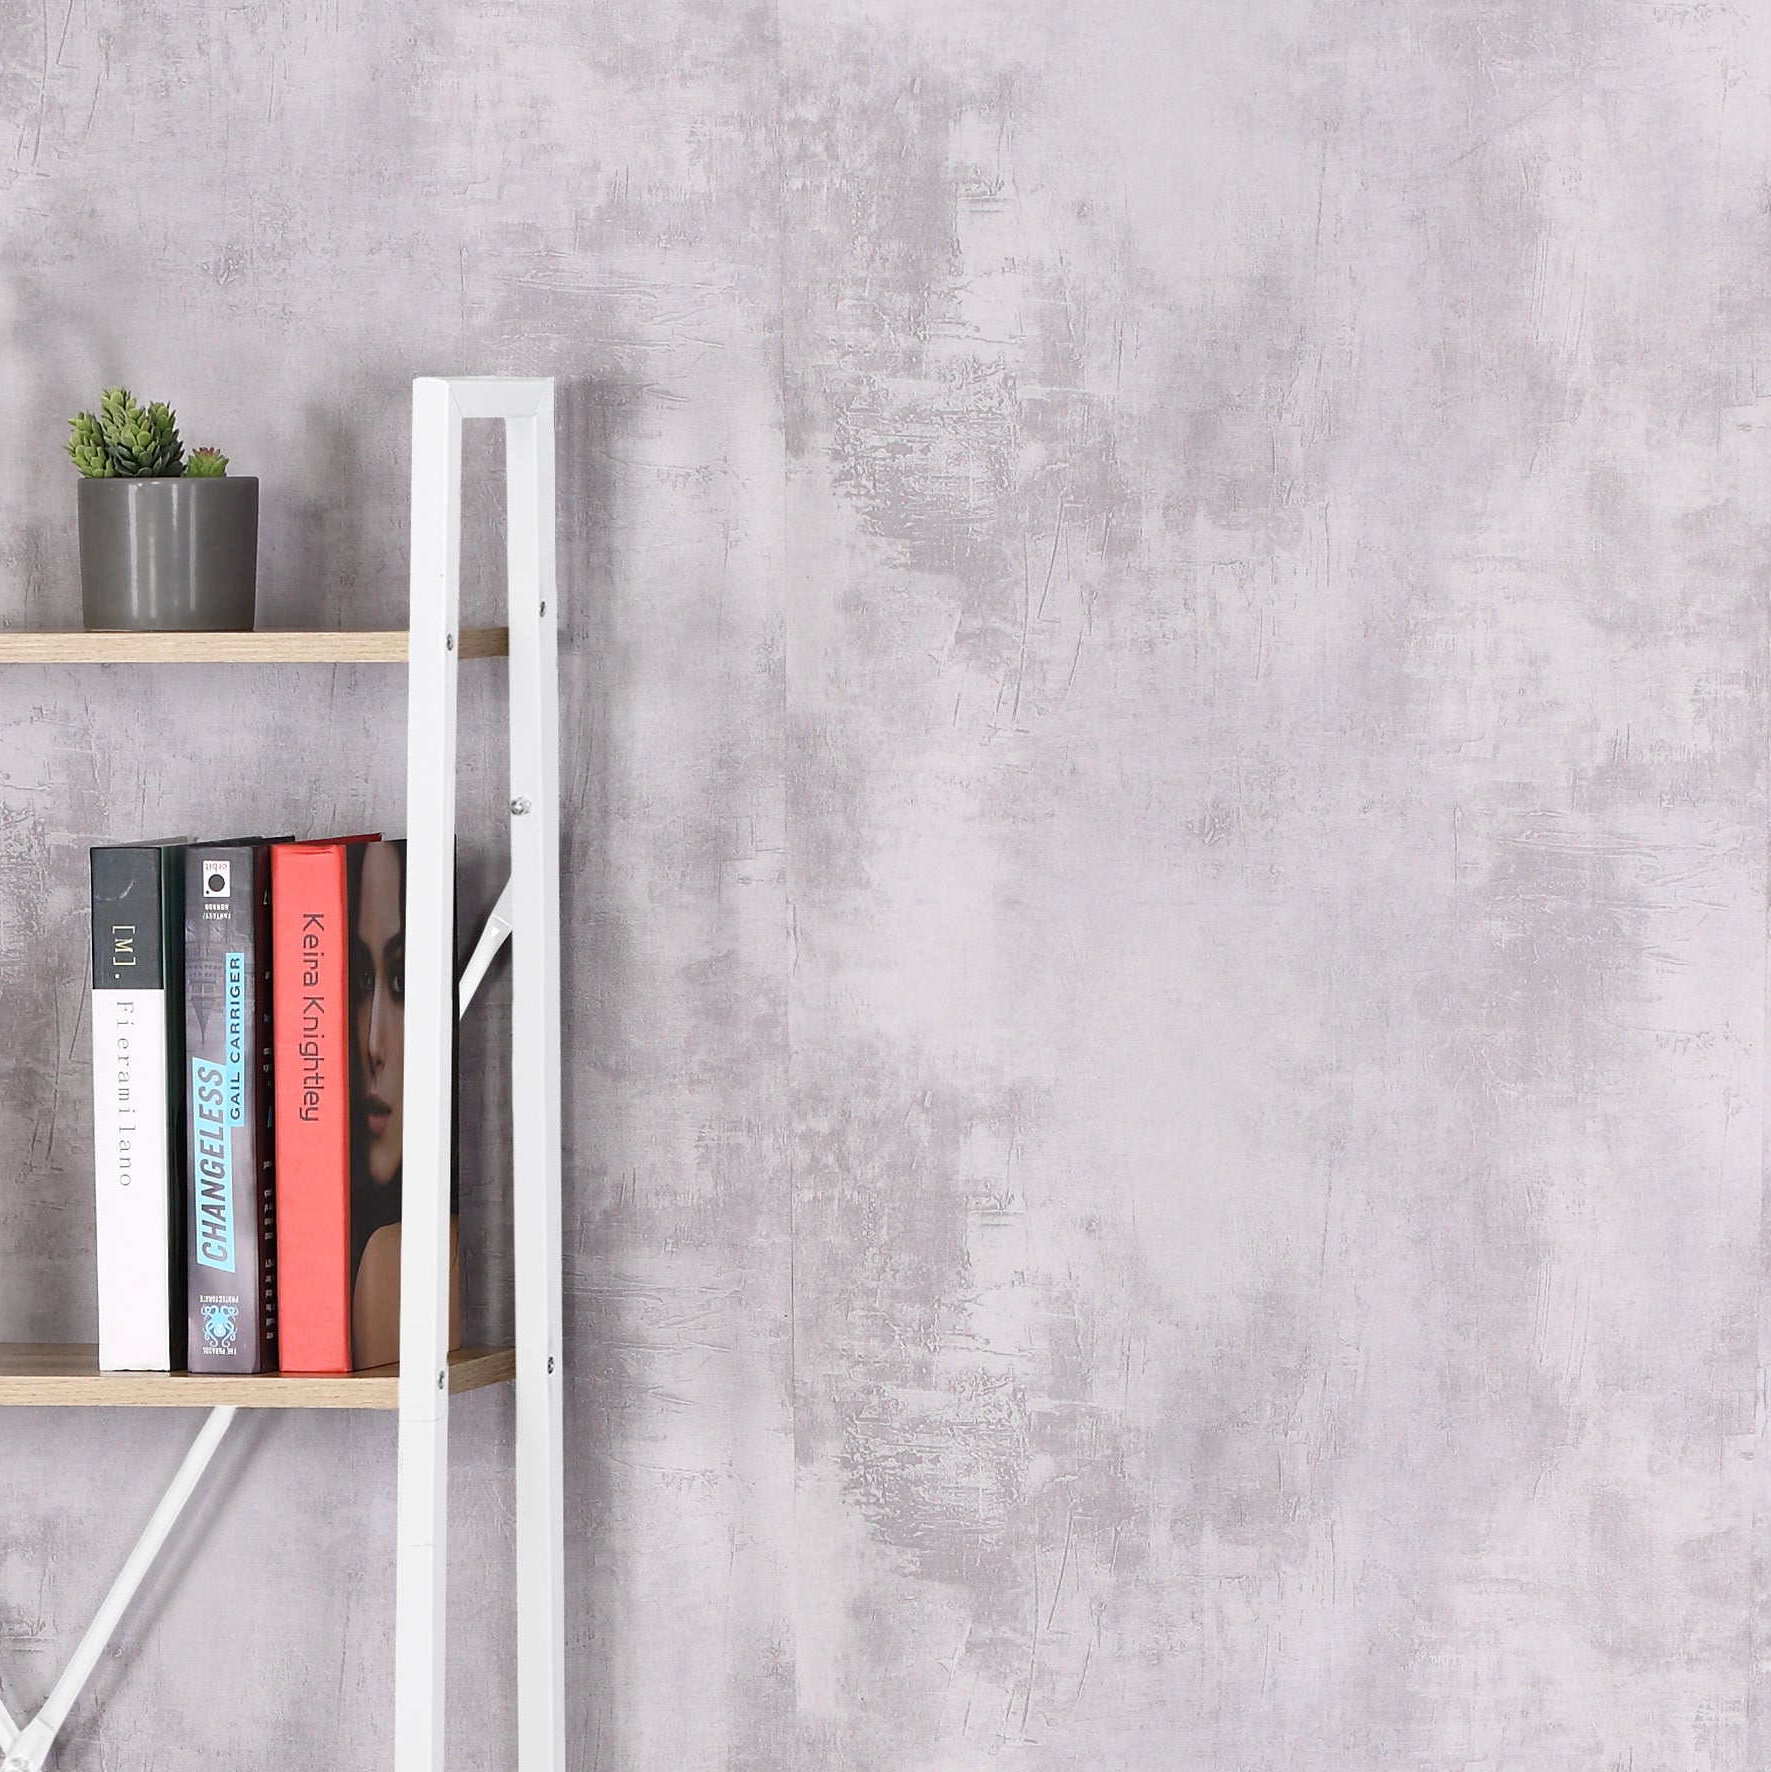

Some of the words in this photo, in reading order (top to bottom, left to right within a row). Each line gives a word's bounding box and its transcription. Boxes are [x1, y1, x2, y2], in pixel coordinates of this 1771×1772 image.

[204, 862, 228, 873] orbit
[302, 913, 326, 988] Keira
[230, 956, 241, 1064] CARRIGER
[299, 996, 326, 1123] Knightley
[116, 1001, 137, 1187] Fieramilano
[230, 1071, 242, 1121] GAIL
[198, 1065, 227, 1263] CHANGELESS
